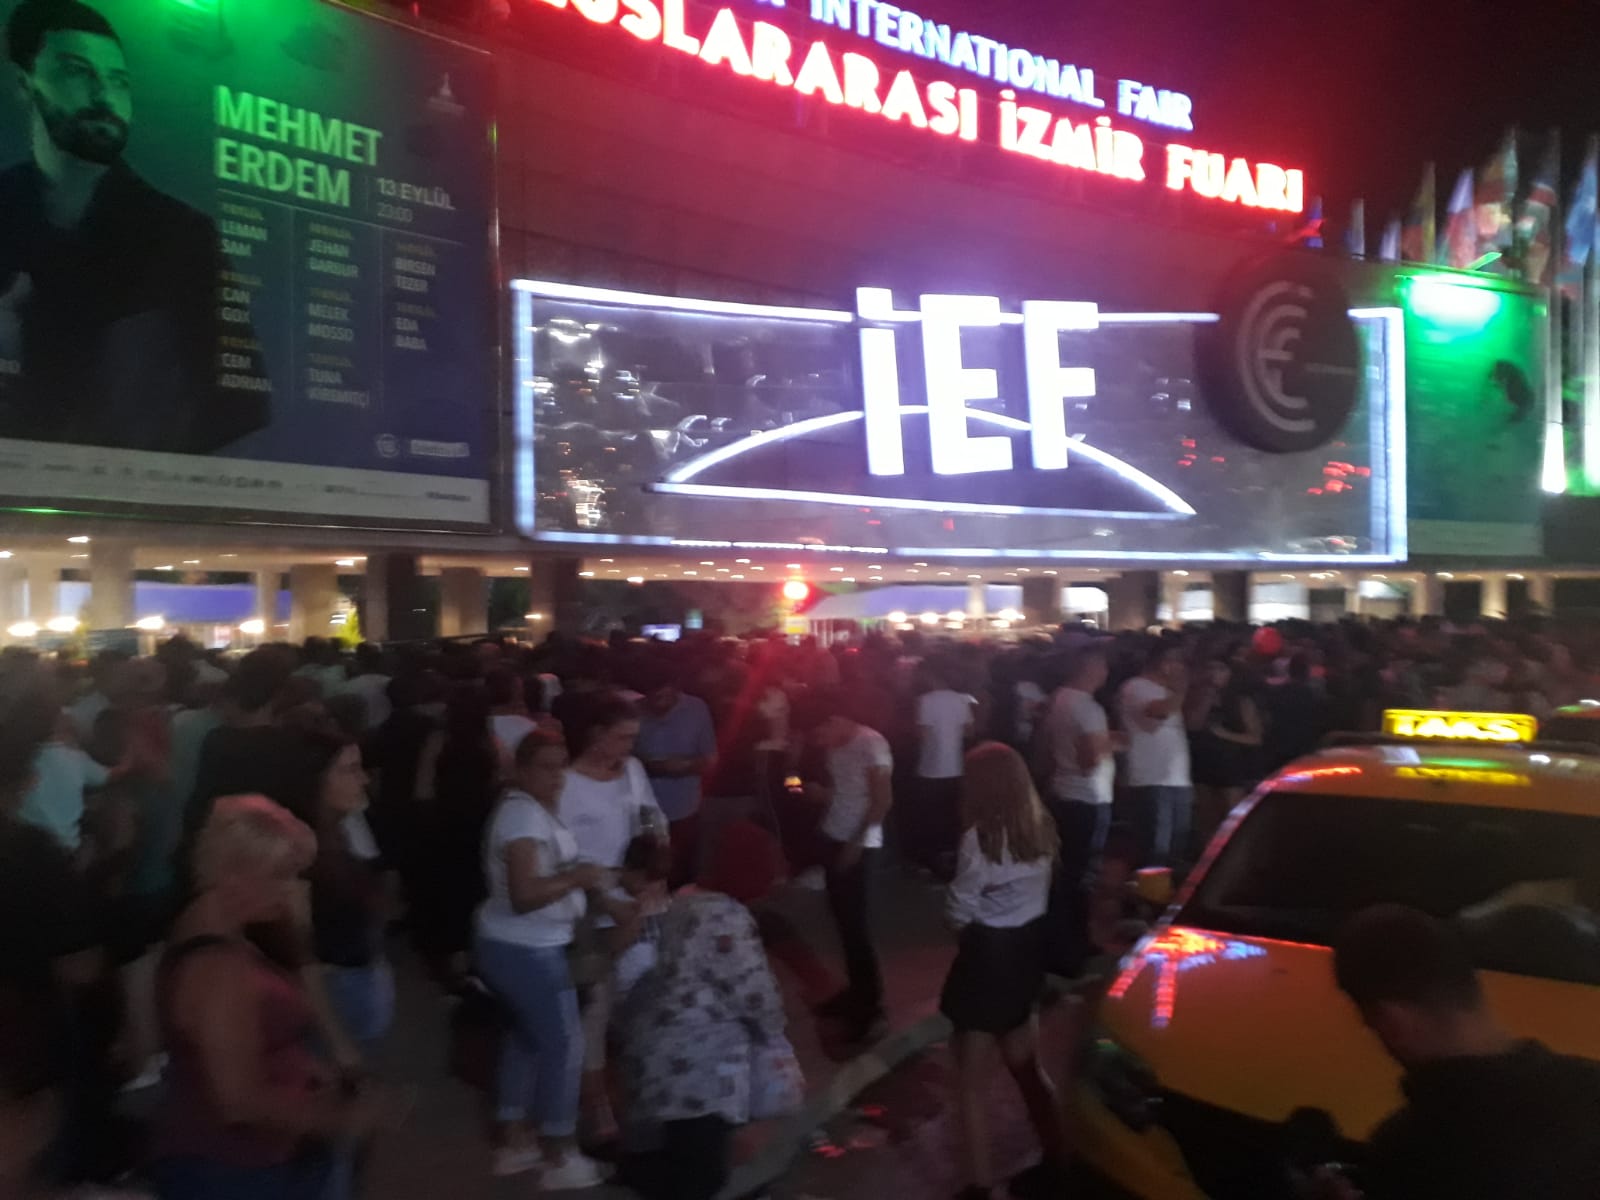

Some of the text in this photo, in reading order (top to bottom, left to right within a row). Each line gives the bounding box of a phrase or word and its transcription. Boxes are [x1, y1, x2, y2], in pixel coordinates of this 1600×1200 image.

[537, 0, 1304, 212] SLARARASI İZMİR FUARI
[811, 0, 1193, 131] INTERNATIONAL FAIR
[214, 85, 383, 166] MEHMET
[213, 137, 350, 208] ERDEM
[377, 177, 456, 210] 13 EYLÜL
